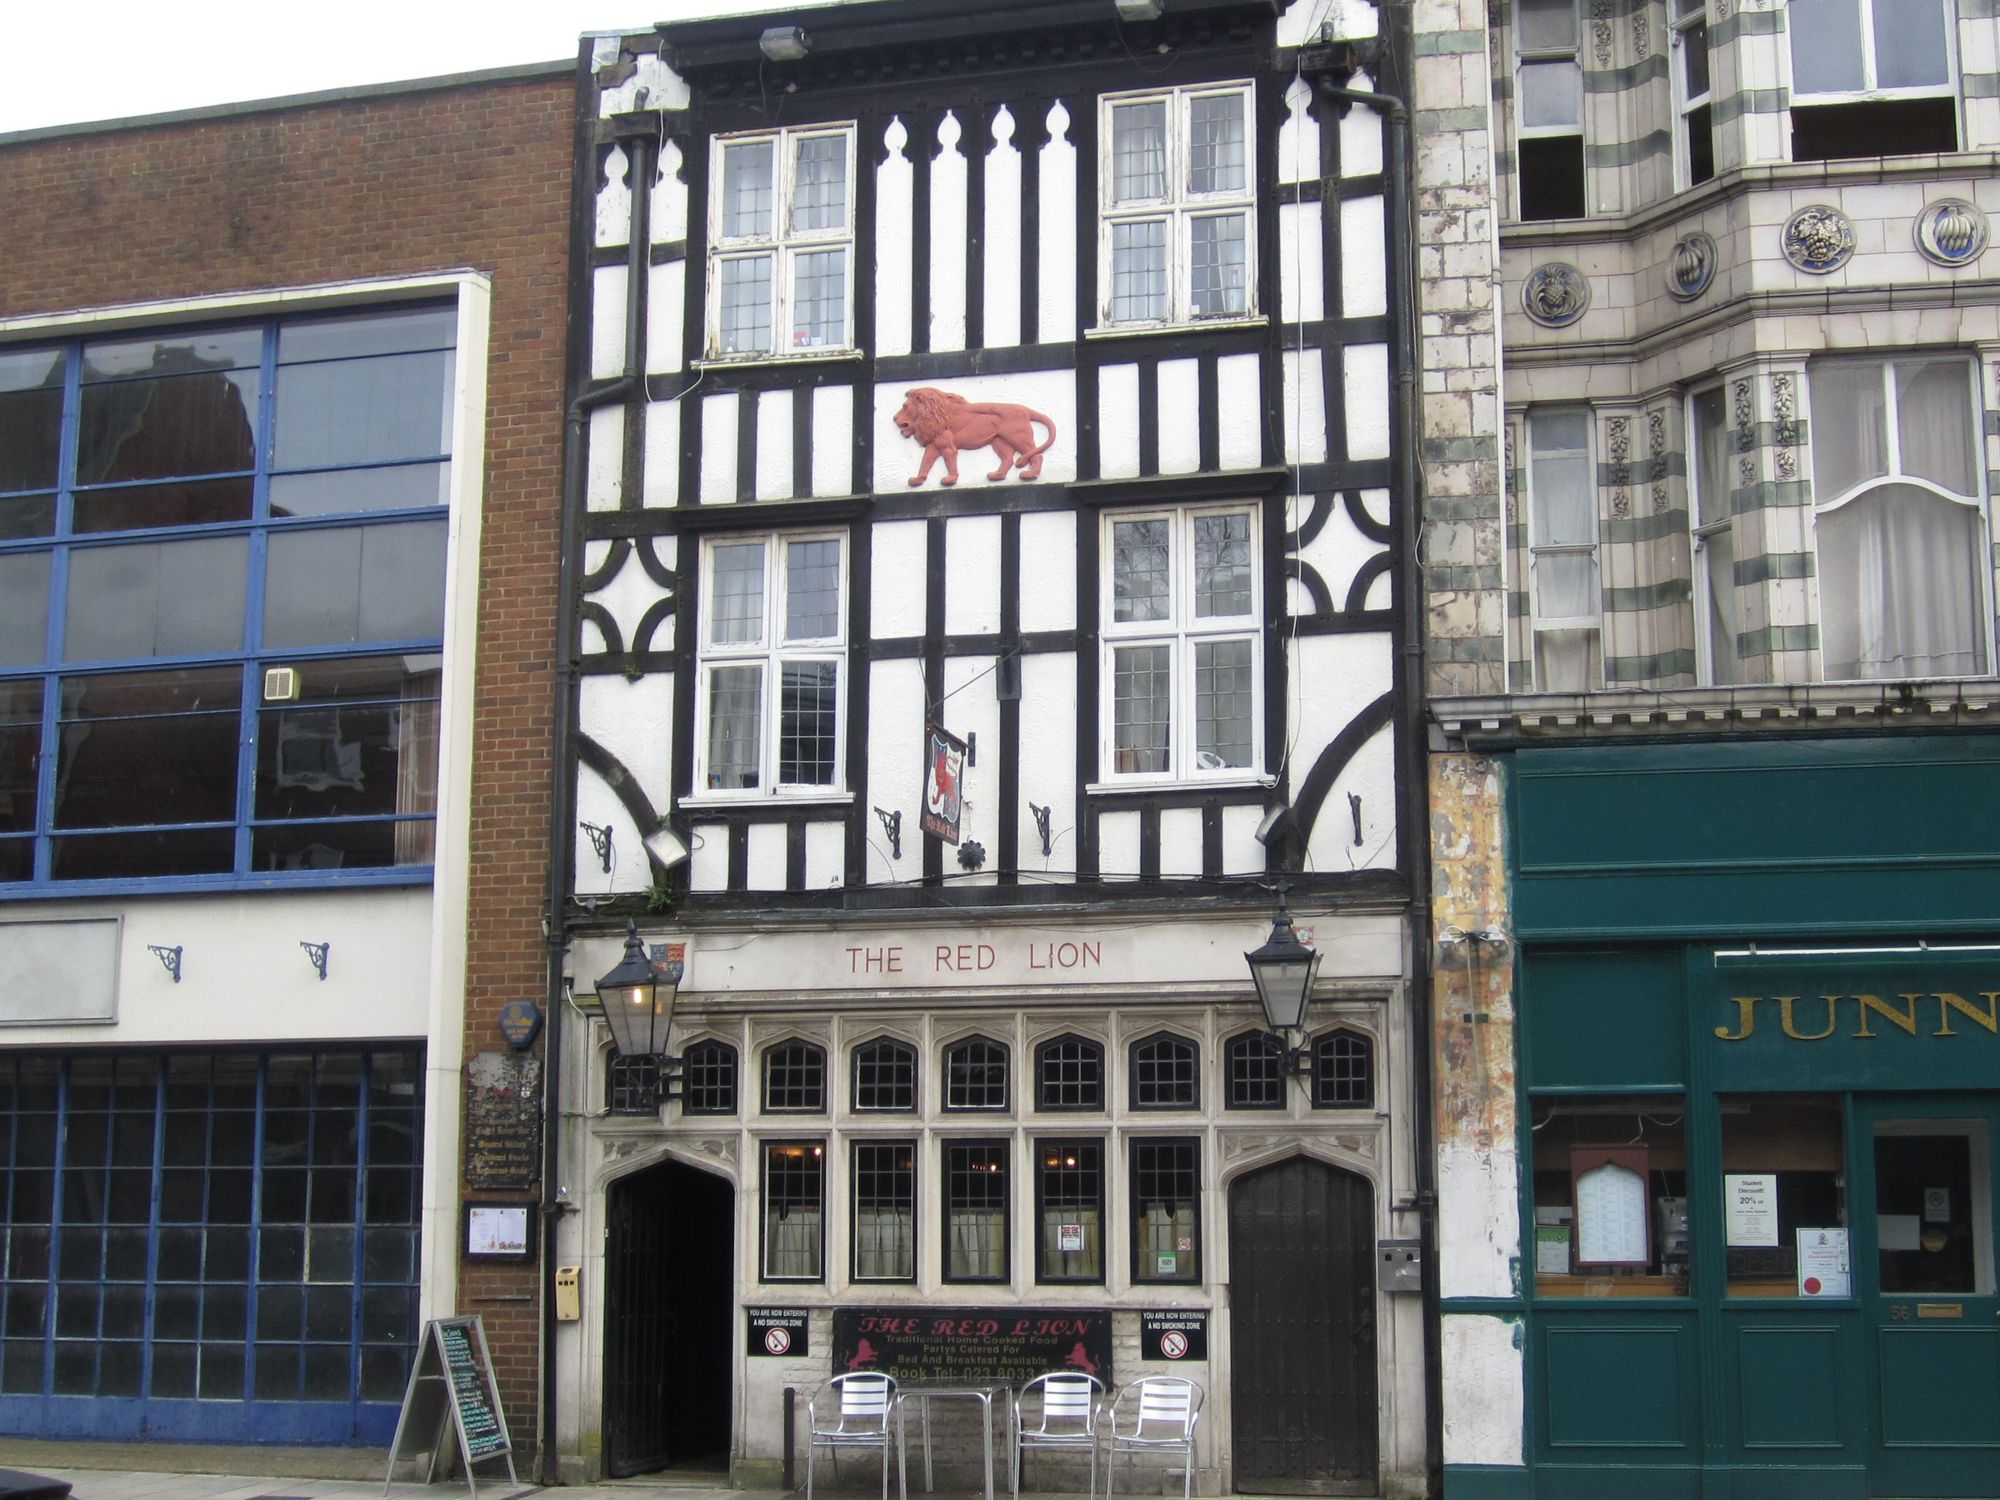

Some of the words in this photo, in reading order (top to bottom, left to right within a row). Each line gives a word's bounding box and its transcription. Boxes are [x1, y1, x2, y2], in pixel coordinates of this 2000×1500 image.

[846, 947, 903, 973] THE
[936, 945, 996, 971] RED
[1030, 942, 1102, 969] LION
[1890, 1306, 1910, 1320] 56
[859, 1317, 920, 1334] THE
[931, 1319, 999, 1335] RED
[1010, 1319, 1090, 1335] LION
[887, 1335, 943, 1344] Traditional
[947, 1336, 979, 1344] Home
[984, 1336, 1025, 1344] Cooked
[1030, 1336, 1058, 1344] Food
[924, 1345, 956, 1354] Partys
[960, 1345, 999, 1353] Catered
[898, 1355, 918, 1363] Bed
[922, 1355, 942, 1363] And
[946, 1356, 997, 1364] Breakfast
[1001, 1356, 1047, 1364] Available
[890, 1366, 929, 1379] Book
[964, 1367, 991, 1380] 023
[997, 1367, 1035, 1380] 8033
